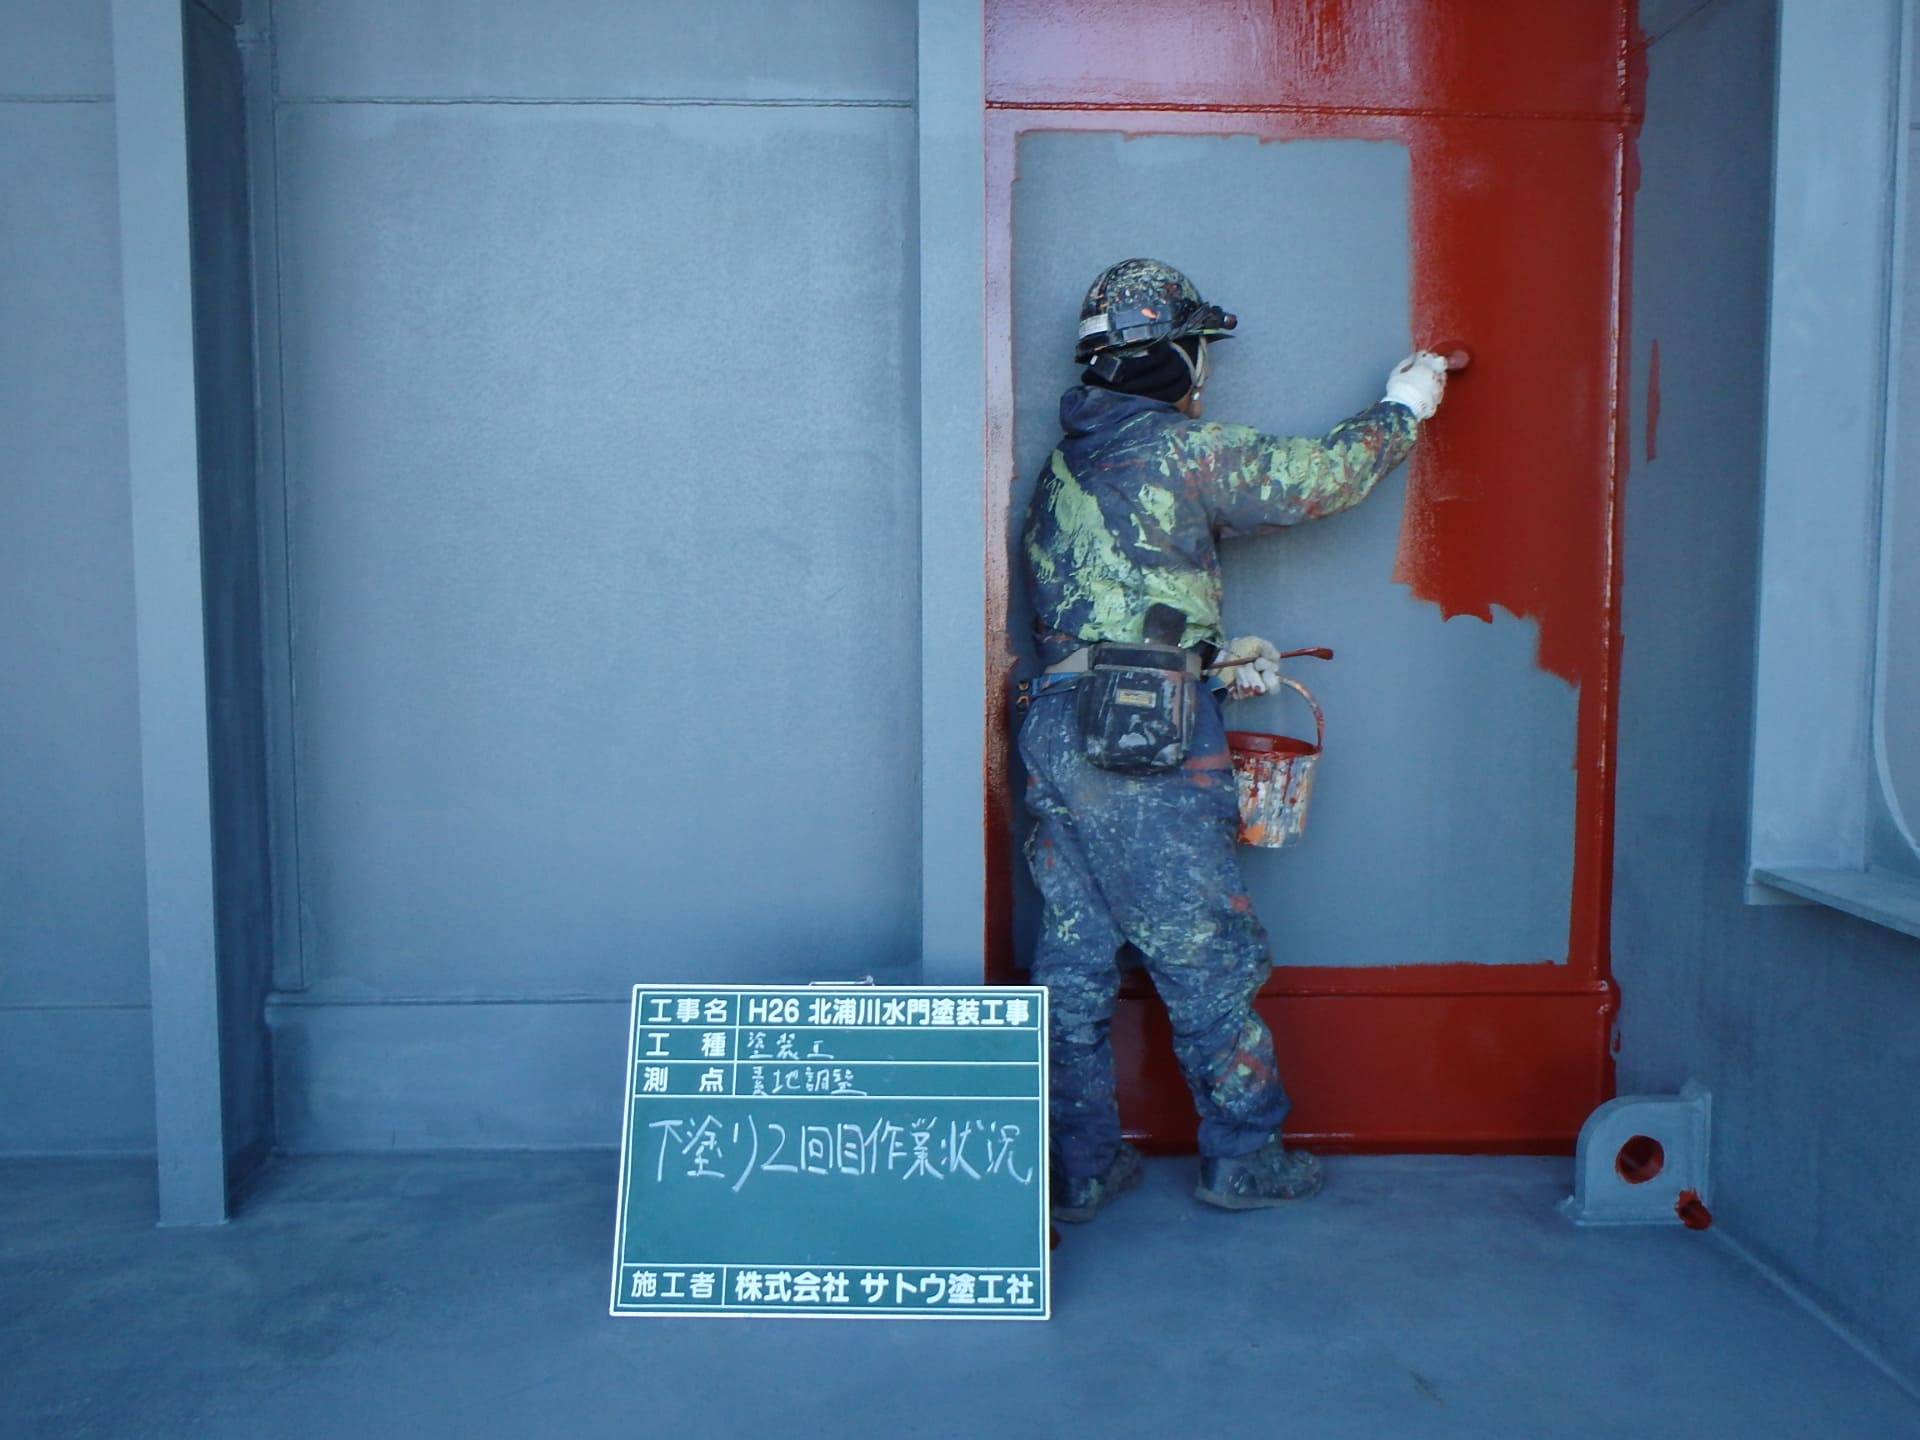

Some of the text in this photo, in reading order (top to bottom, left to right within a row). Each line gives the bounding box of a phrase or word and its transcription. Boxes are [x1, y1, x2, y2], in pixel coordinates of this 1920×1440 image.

[647, 998, 729, 1023] 工事名
[748, 998, 1030, 1026] H26 北浦川水門塗装工事
[630, 1271, 716, 1299] 施工者
[734, 1271, 1035, 1306] 株式会社 サトウ塗工社
